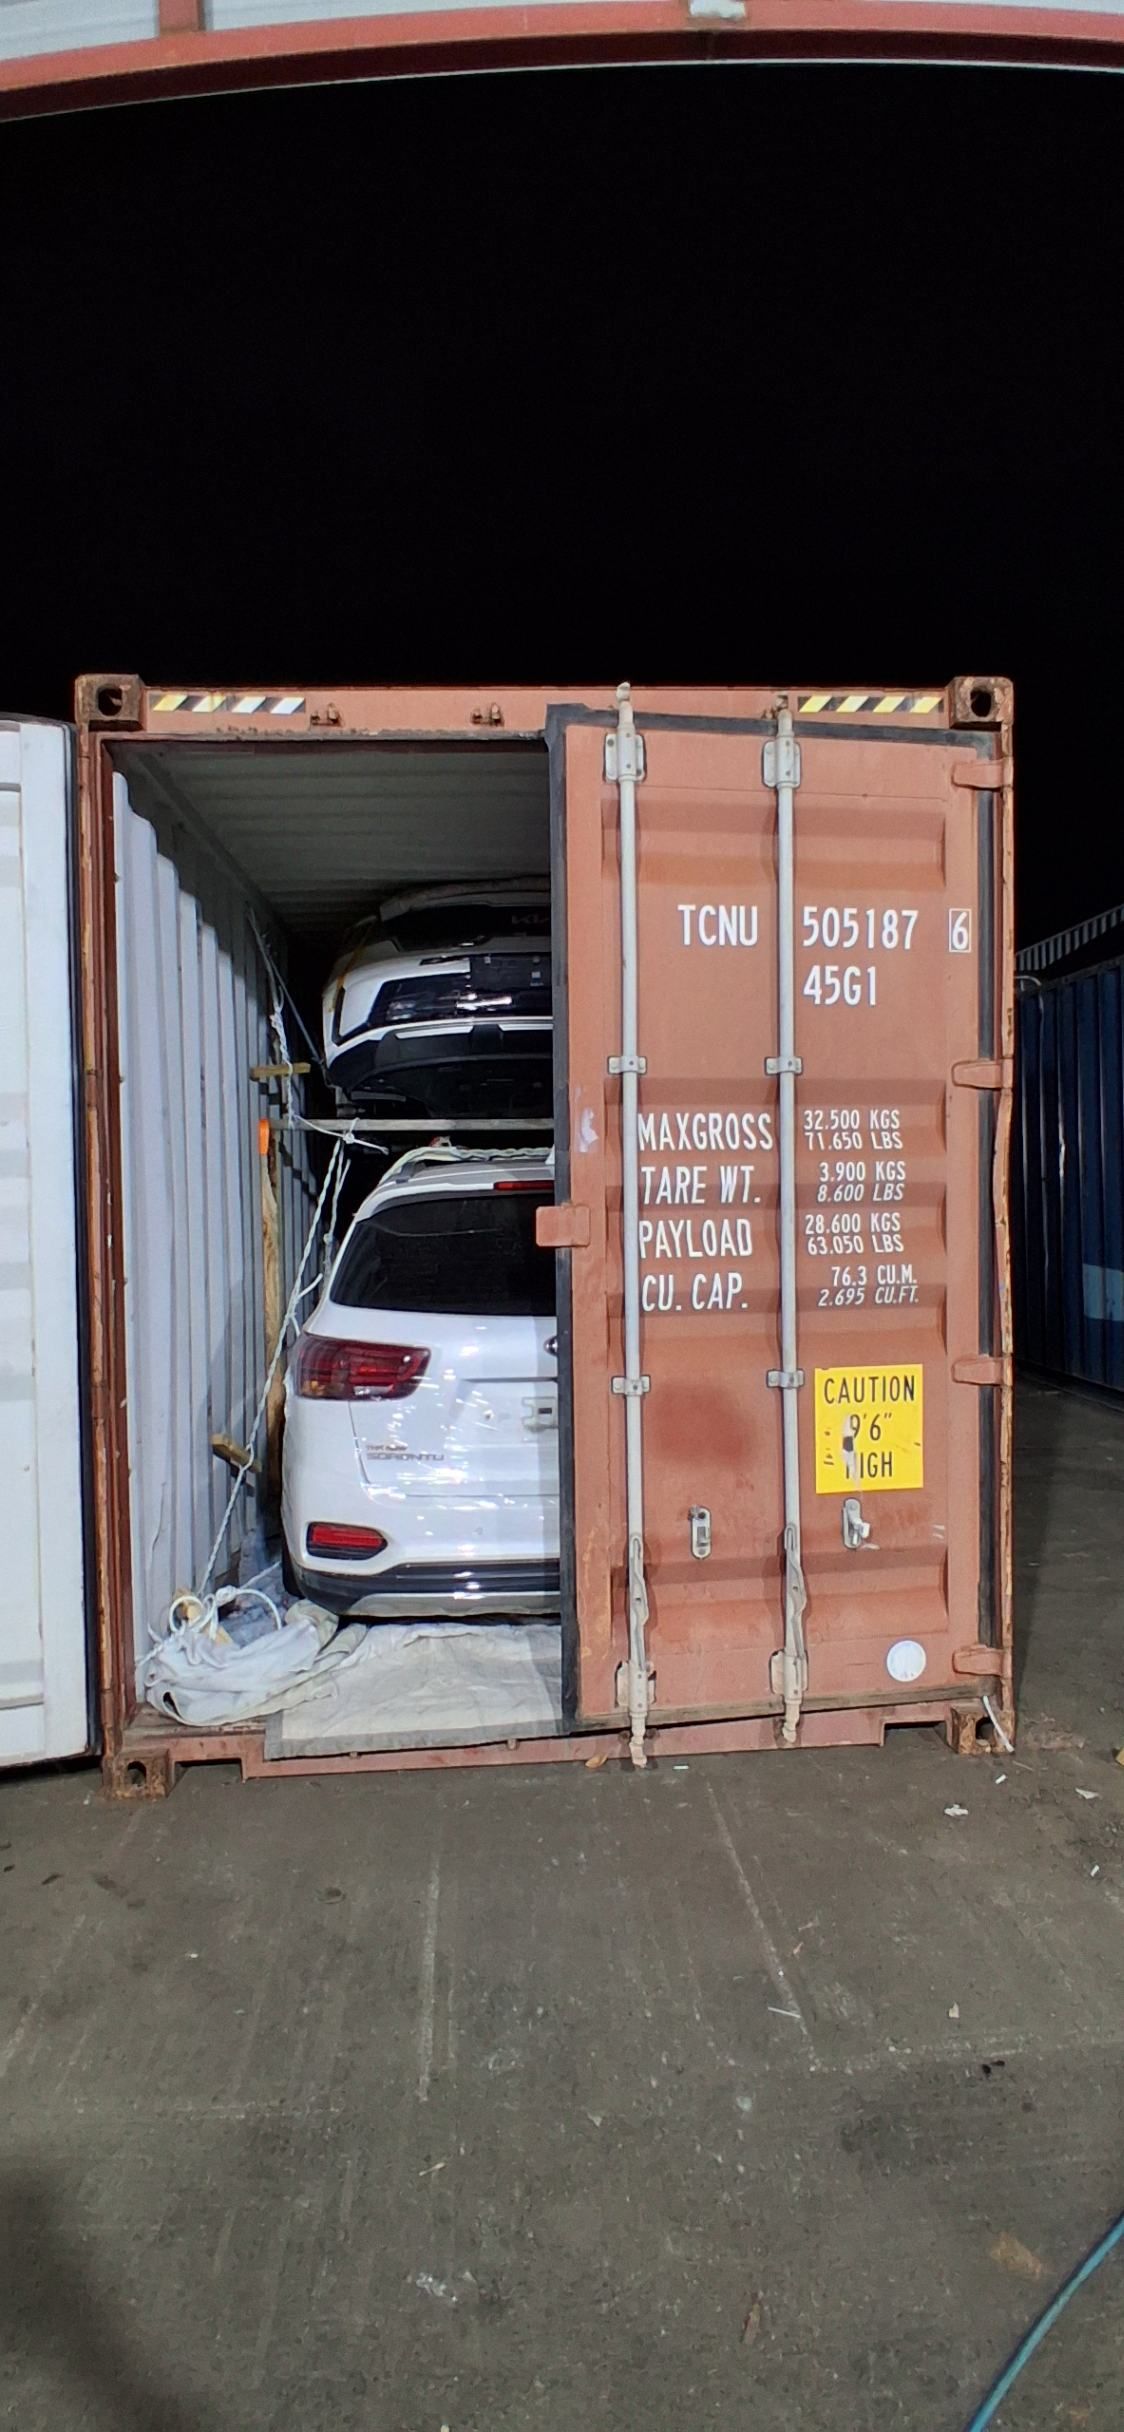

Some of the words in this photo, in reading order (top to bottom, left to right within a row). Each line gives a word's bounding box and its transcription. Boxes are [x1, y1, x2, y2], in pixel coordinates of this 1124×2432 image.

[677, 904, 758, 946] TCNU
[802, 906, 919, 950] 505187
[951, 910, 969, 951] 6
[803, 965, 877, 1006] 45G1
[804, 1110, 860, 1130] 32.500
[870, 1109, 900, 1129] KGS
[638, 1112, 773, 1151] MAXGROSS
[804, 1132, 862, 1151] 71.650
[871, 1132, 904, 1150] LBS
[819, 1161, 866, 1182] 3.900
[875, 1161, 906, 1181] KGS
[641, 1166, 707, 1205] TARE
[720, 1165, 761, 1204] WT.
[817, 1183, 864, 1203] 8.600
[873, 1183, 904, 1202] LBS
[805, 1212, 861, 1235] 28.600
[870, 1212, 901, 1233] KGS
[639, 1218, 753, 1259] PAYLOAD
[807, 1235, 864, 1255] 63.050
[872, 1234, 904, 1253] LBS
[831, 1265, 867, 1287] 76.3
[877, 1264, 918, 1284] CU.M.
[642, 1274, 682, 1311] CU.
[691, 1272, 748, 1310] CAP.
[818, 1287, 865, 1307] 2.695
[875, 1285, 919, 1305] CU.FT.
[823, 1374, 915, 1405] CAUTION
